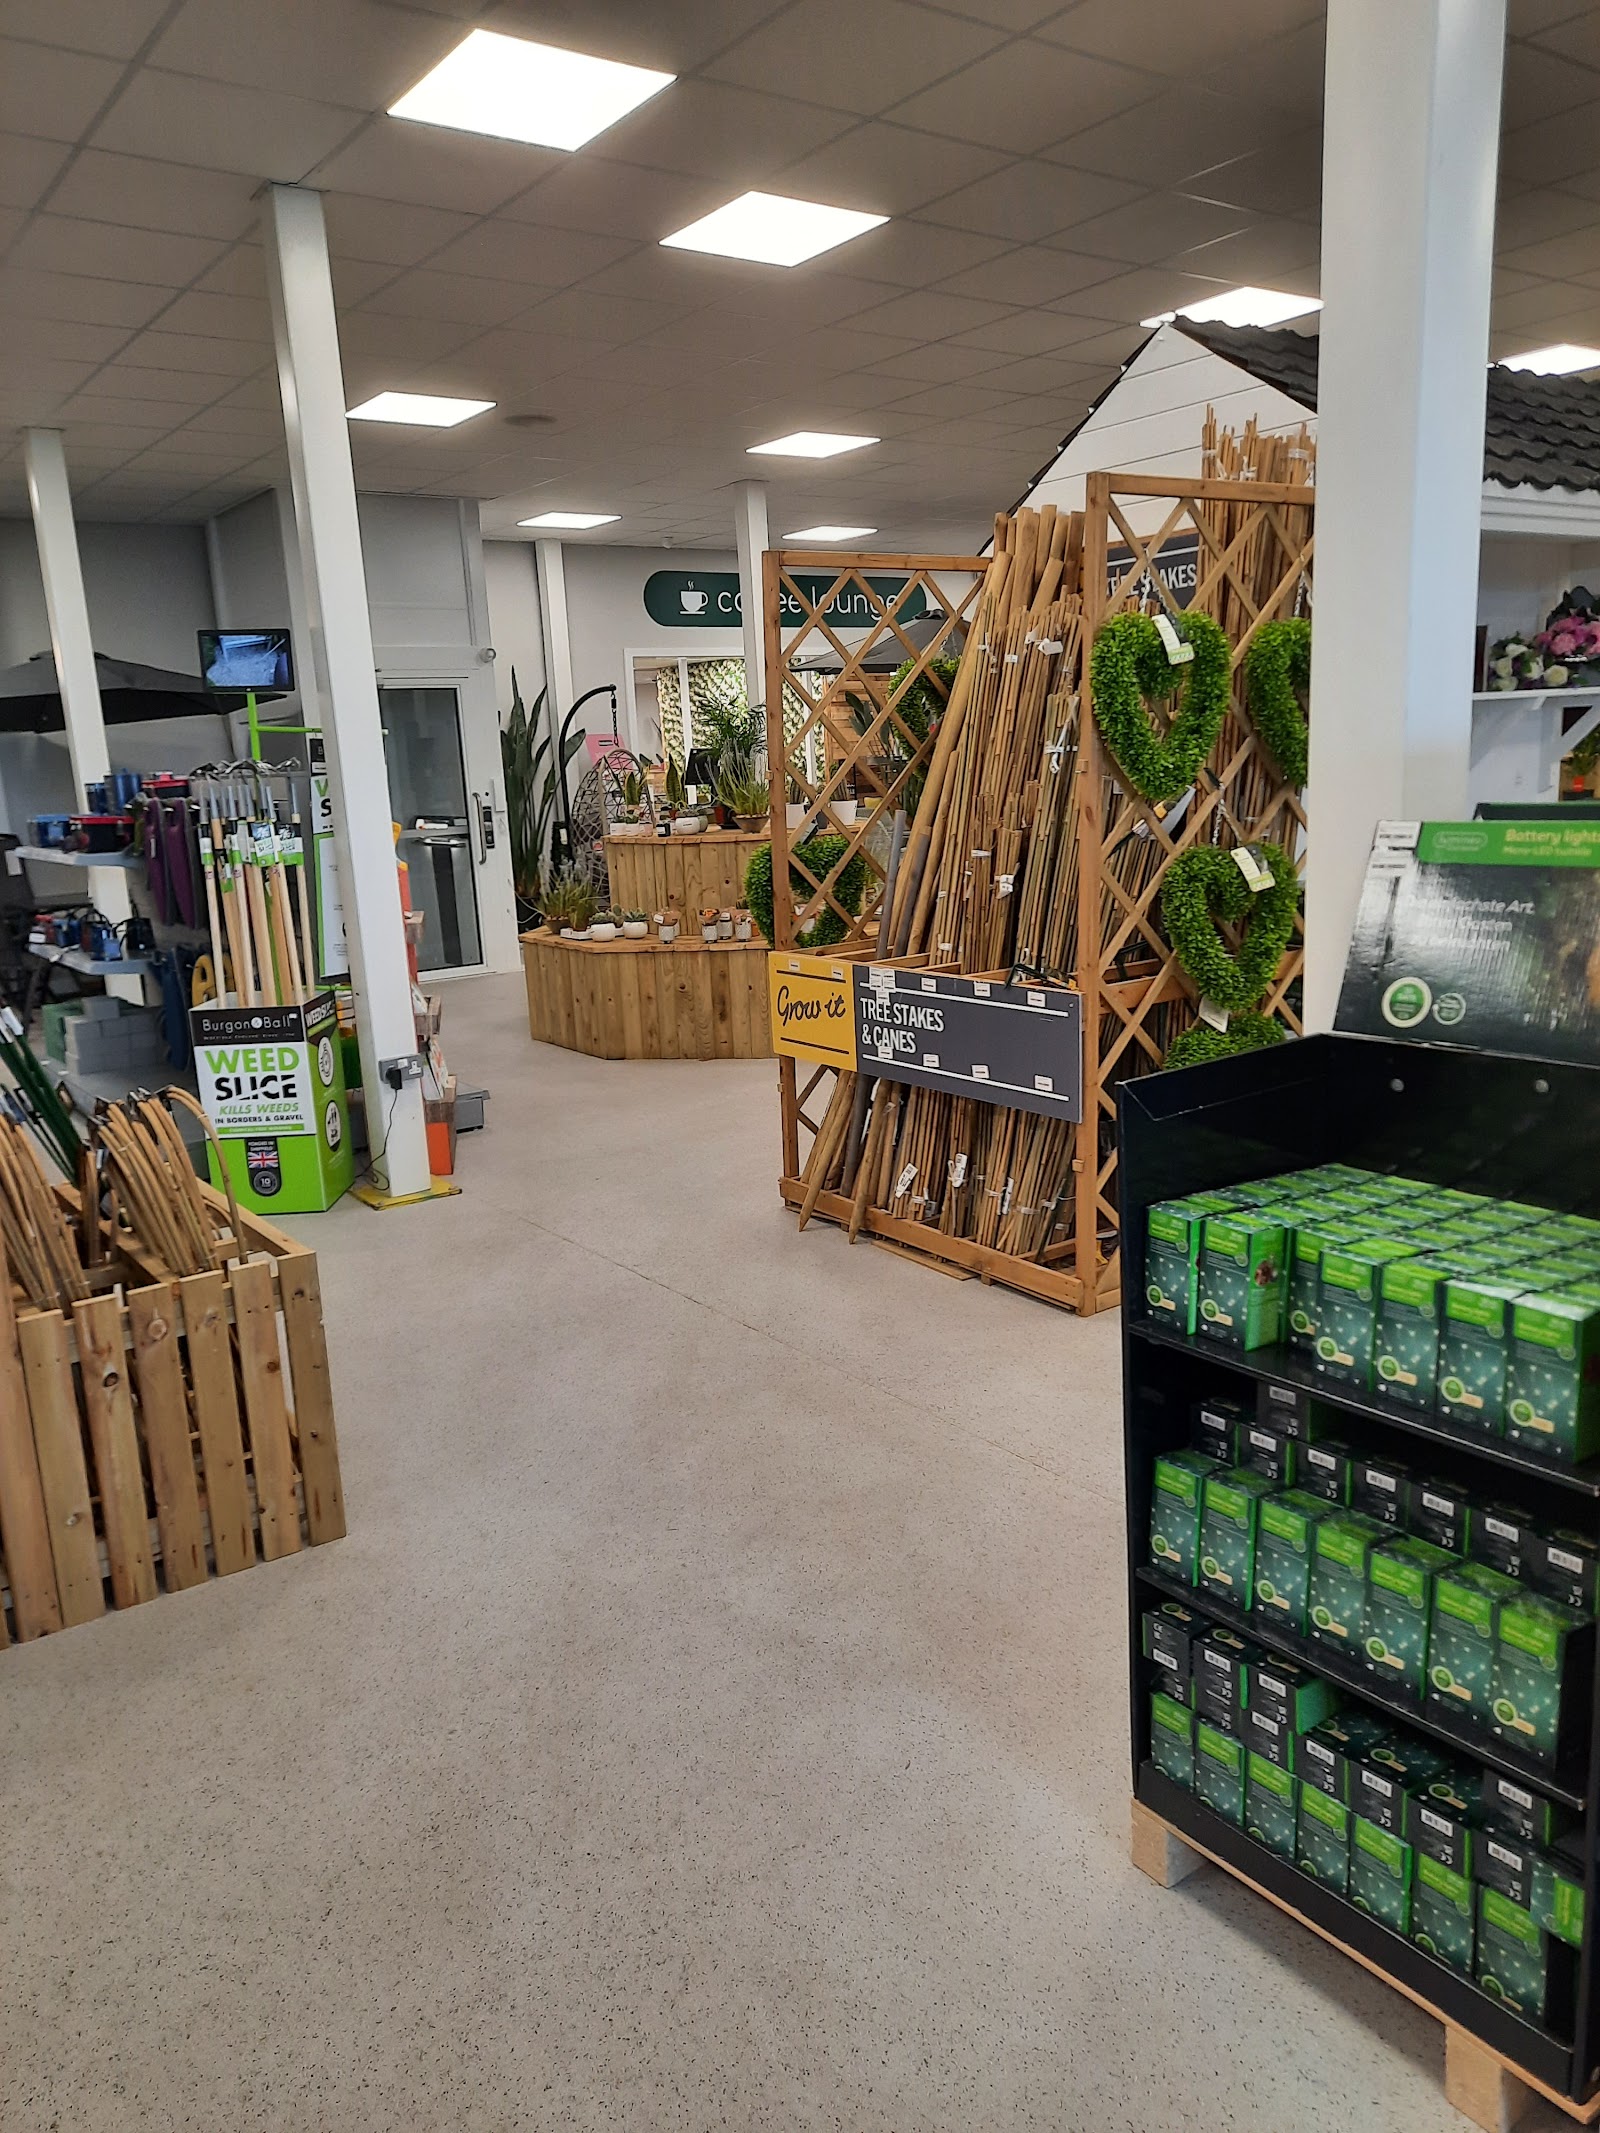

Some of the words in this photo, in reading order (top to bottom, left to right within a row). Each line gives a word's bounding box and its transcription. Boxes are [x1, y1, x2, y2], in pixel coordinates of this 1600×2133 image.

[1505, 829, 1560, 845] Battery
[777, 985, 822, 1027] Grow
[826, 991, 847, 1019] it
[860, 997, 892, 1023] TREE
[893, 1002, 945, 1032] STAKES
[202, 1018, 251, 1034] Burgon
[263, 1015, 290, 1028] Ball
[862, 1023, 873, 1045] &
[873, 1025, 917, 1054] CANES
[204, 1047, 300, 1074] WEED
[215, 1074, 297, 1101] SLICE
[219, 1104, 252, 1116] KILLS
[257, 1102, 299, 1114] WEEDS
[226, 1116, 262, 1124] BORDERS
[260, 1177, 271, 1185] 10
